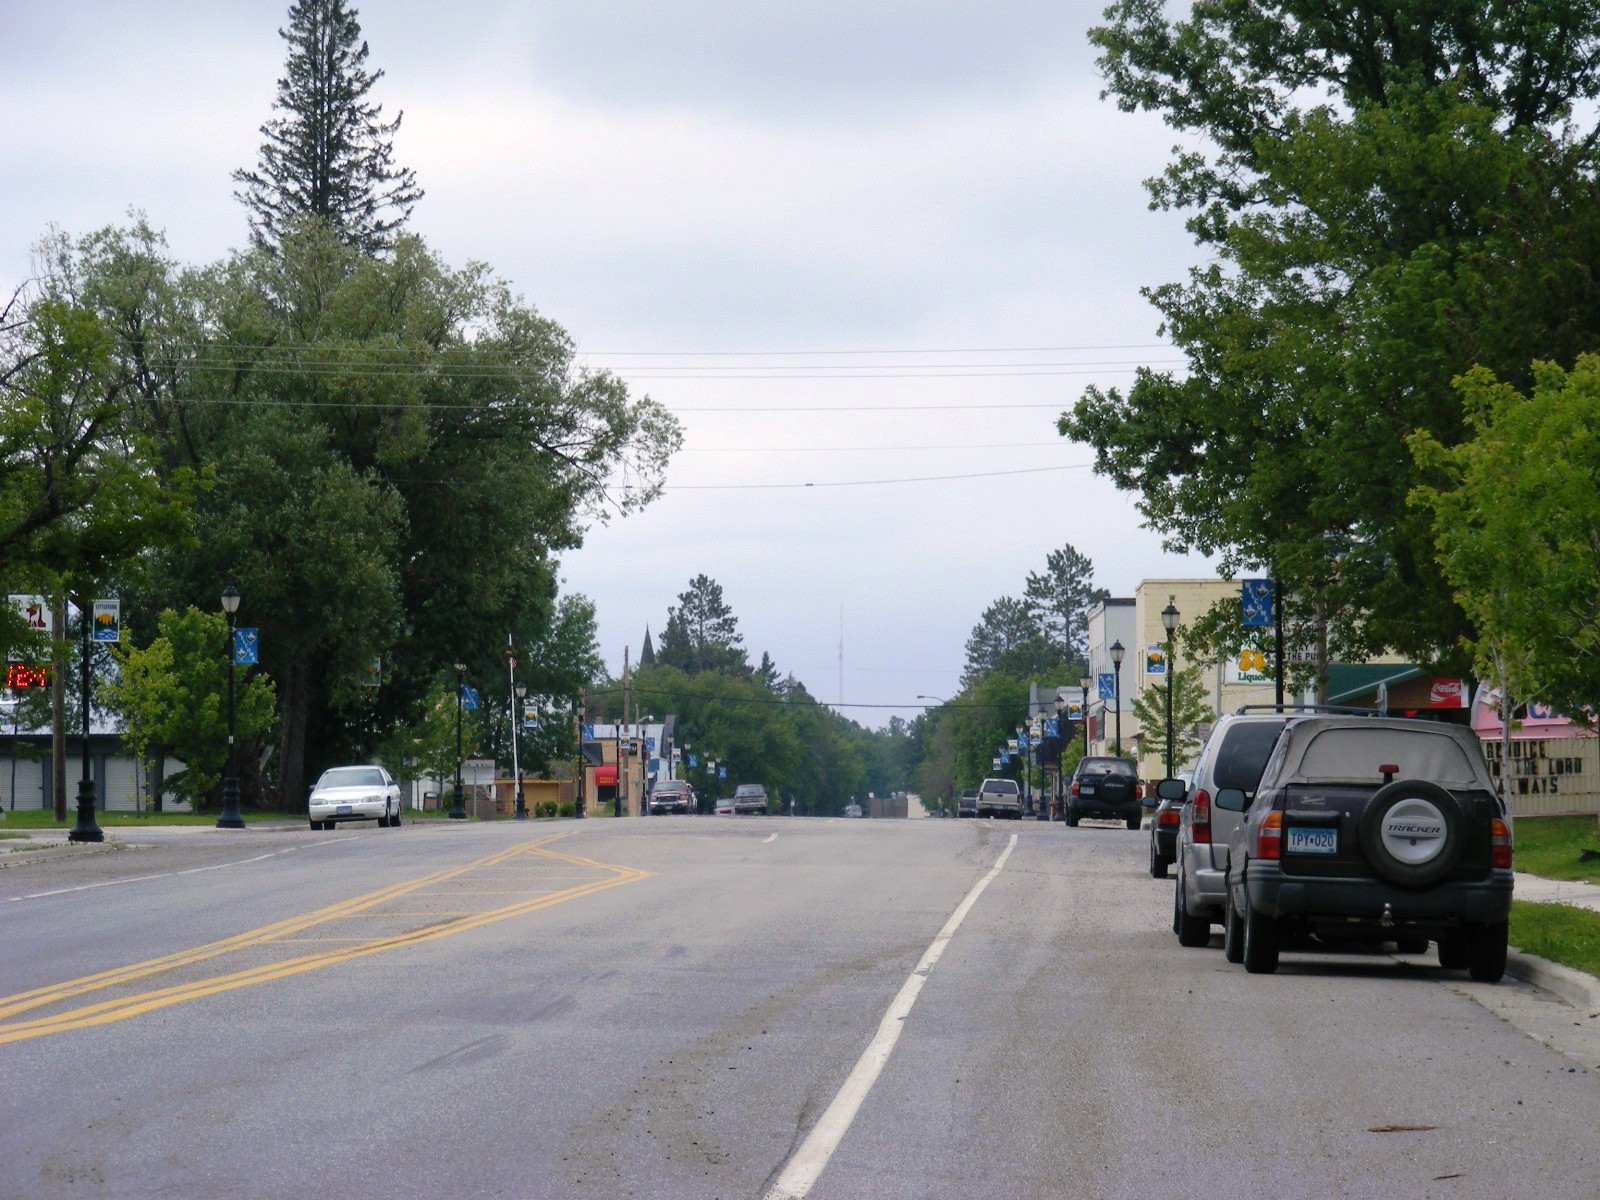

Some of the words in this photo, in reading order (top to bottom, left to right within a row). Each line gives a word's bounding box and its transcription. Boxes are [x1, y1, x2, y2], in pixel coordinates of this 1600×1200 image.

[1245, 582, 1269, 623] WELCOME
[1287, 652, 1302, 660] THE
[1238, 672, 1266, 682] Liquor
[1515, 758, 1538, 775] THE
[1549, 757, 1582, 775] LORD
[1496, 776, 1558, 795] AWAYS
[1388, 824, 1441, 834] TRACKER
